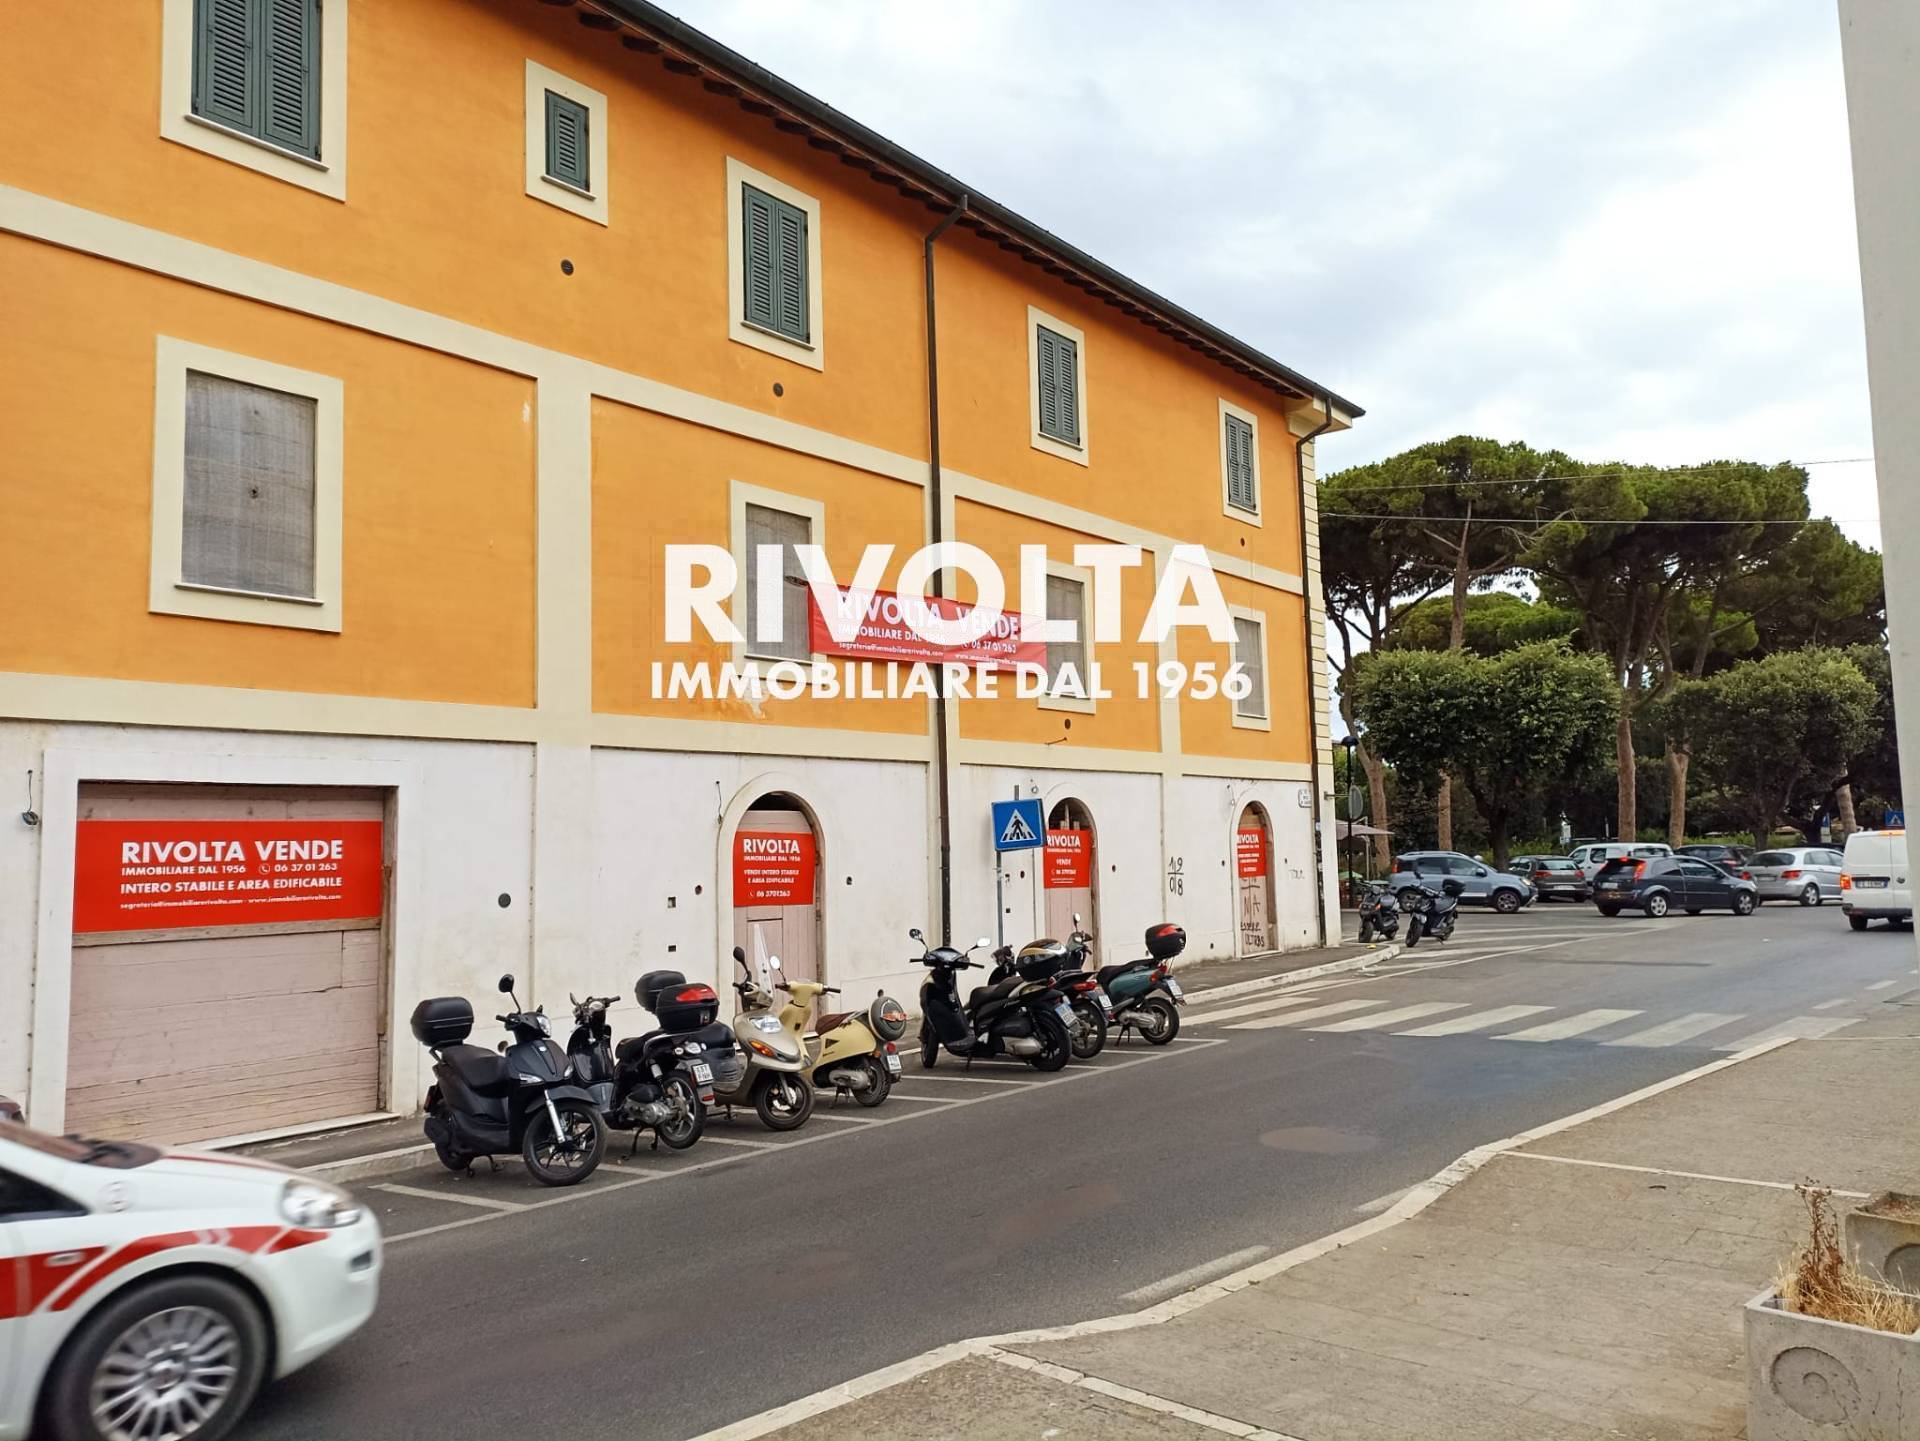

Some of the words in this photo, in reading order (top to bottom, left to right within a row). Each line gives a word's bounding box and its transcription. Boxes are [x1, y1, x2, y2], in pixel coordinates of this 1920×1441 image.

[743, 838, 800, 854] RIVOLTA
[1046, 835, 1081, 847] RIVOLTA
[122, 841, 246, 863] RIVOLTA
[255, 840, 343, 860] VENDE
[122, 866, 195, 876] IMMOBILIARE
[198, 865, 218, 874] DAL
[222, 864, 246, 874] 1956
[274, 864, 288, 873] 06
[291, 863, 303, 872] 37
[305, 863, 316, 871] 01
[319, 862, 337, 871] 263
[120, 882, 172, 894] INTERO
[175, 881, 225, 892] STABILE
[228, 880, 235, 890] E
[237, 879, 270, 890] AREA
[273, 877, 343, 889] EDIFICABILE
